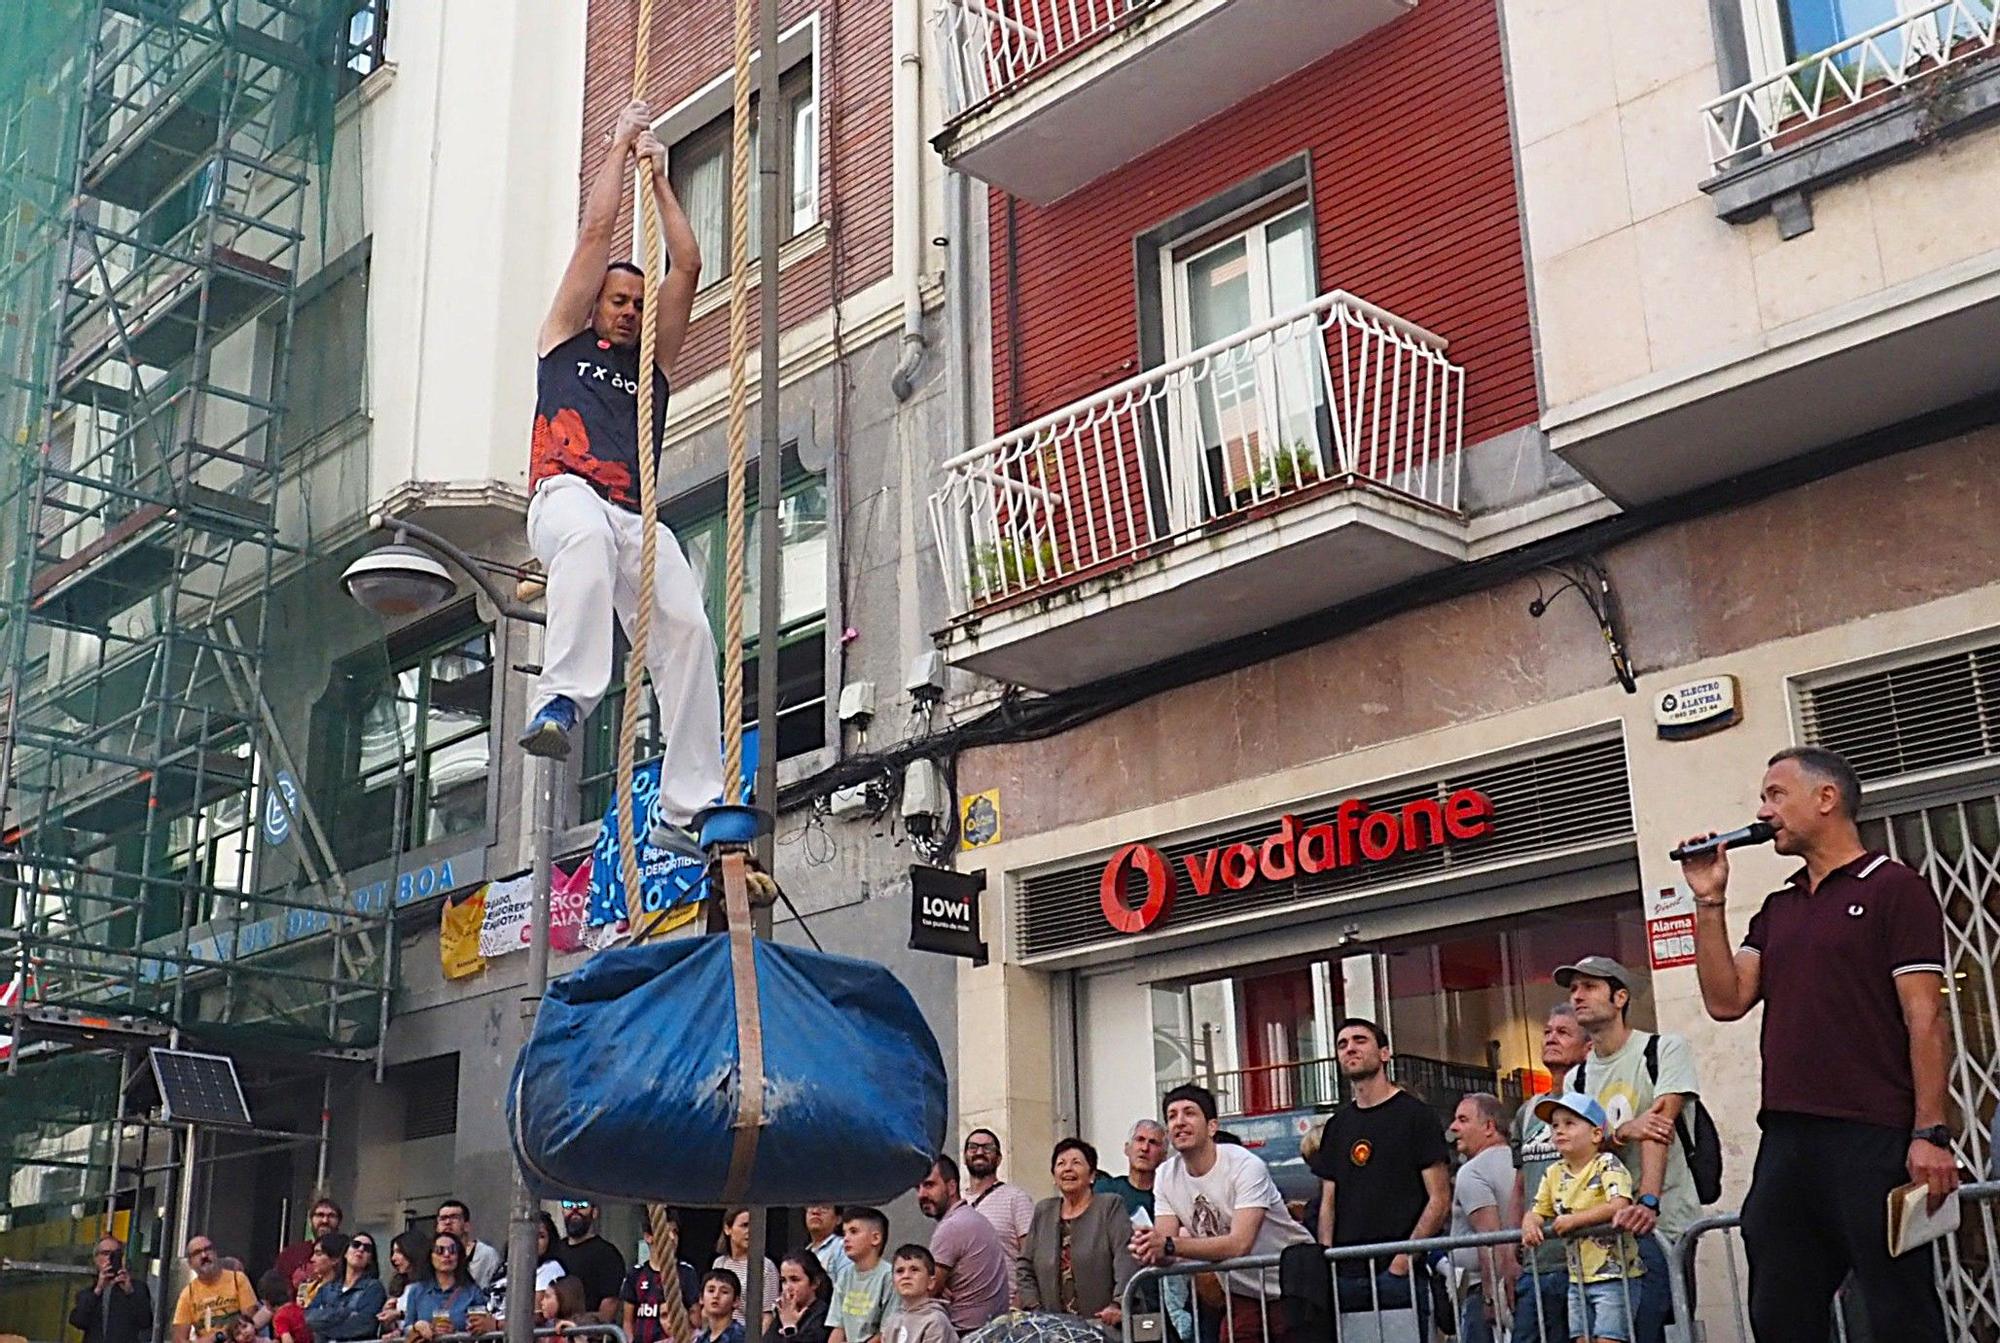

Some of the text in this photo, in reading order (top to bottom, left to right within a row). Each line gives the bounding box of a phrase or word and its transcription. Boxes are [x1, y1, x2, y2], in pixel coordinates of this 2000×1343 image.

[1680, 681, 1720, 698] ELECTRO
[1681, 693, 1722, 710] ALAVESA
[1184, 788, 1492, 896] vodafone
[1652, 918, 1692, 934] Alarma
